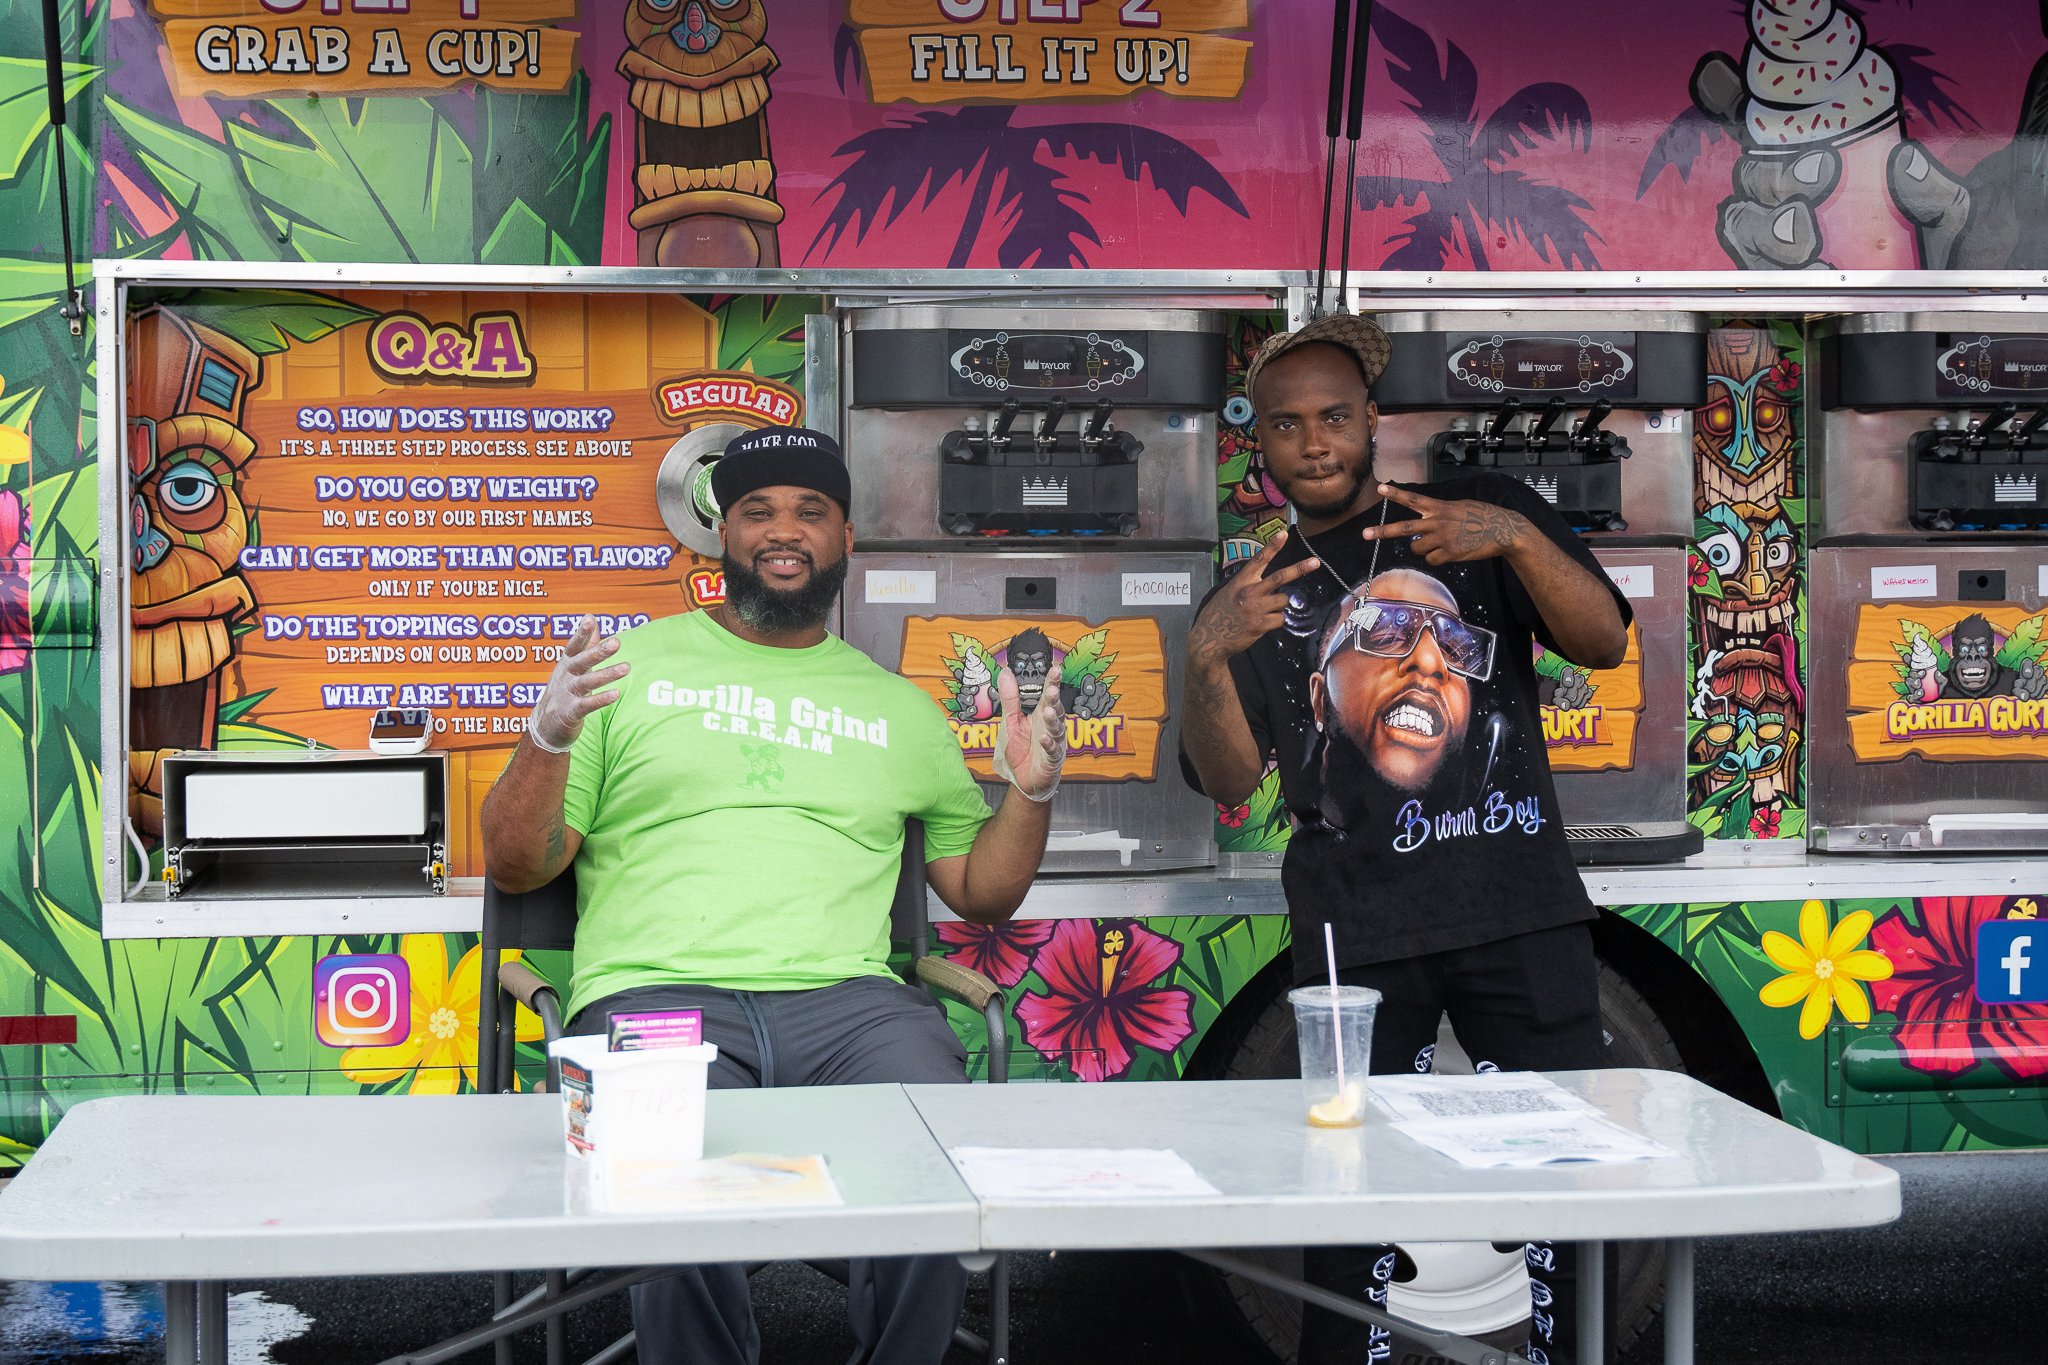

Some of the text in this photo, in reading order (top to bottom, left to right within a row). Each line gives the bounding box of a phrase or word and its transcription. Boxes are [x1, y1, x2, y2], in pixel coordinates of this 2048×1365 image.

[195, 26, 540, 75] GRAB A CUP!
[909, 35, 1190, 84] FILL IT UP!
[377, 321, 527, 373] Q&A
[1040, 362, 1070, 370] TAYLOR
[1533, 364, 1562, 372] TAYLOR
[2019, 364, 2047, 372] TAYLOR
[667, 384, 791, 420] REGULAR
[299, 408, 613, 430] SO, HOW DOES THIS WORK?
[280, 439, 632, 456] IT'S A THREE STEP PROCESS. SEE ABOVE
[317, 477, 596, 498] DO YOU GO BY WEIGHT?
[323, 509, 593, 528] NO, WE GO BY OUR FIRST NAMES
[240, 546, 672, 568] CAN I GET MORE THAN ONE FLAVOR?
[368, 579, 548, 597] ONLY IF YOU'RE NICE.
[1125, 579, 1189, 598] Chocolate
[265, 615, 648, 637] DO THE TOPPINGS COST EXRA?
[326, 645, 566, 663] DEPENDS ON OUR MOOD TOD
[323, 684, 547, 706] WHAT ARE THE SIZ
[451, 717, 487, 733] THE
[492, 716, 530, 734] RIGH
[648, 679, 776, 722] Gorilla
[790, 696, 888, 749] Grind
[1889, 701, 1986, 736] GORILLA
[702, 711, 833, 755] C.R.E.A.M
[1064, 716, 1122, 750] URT
[1392, 790, 1547, 853] Burna Boy
[623, 1085, 689, 1118] TIPS
